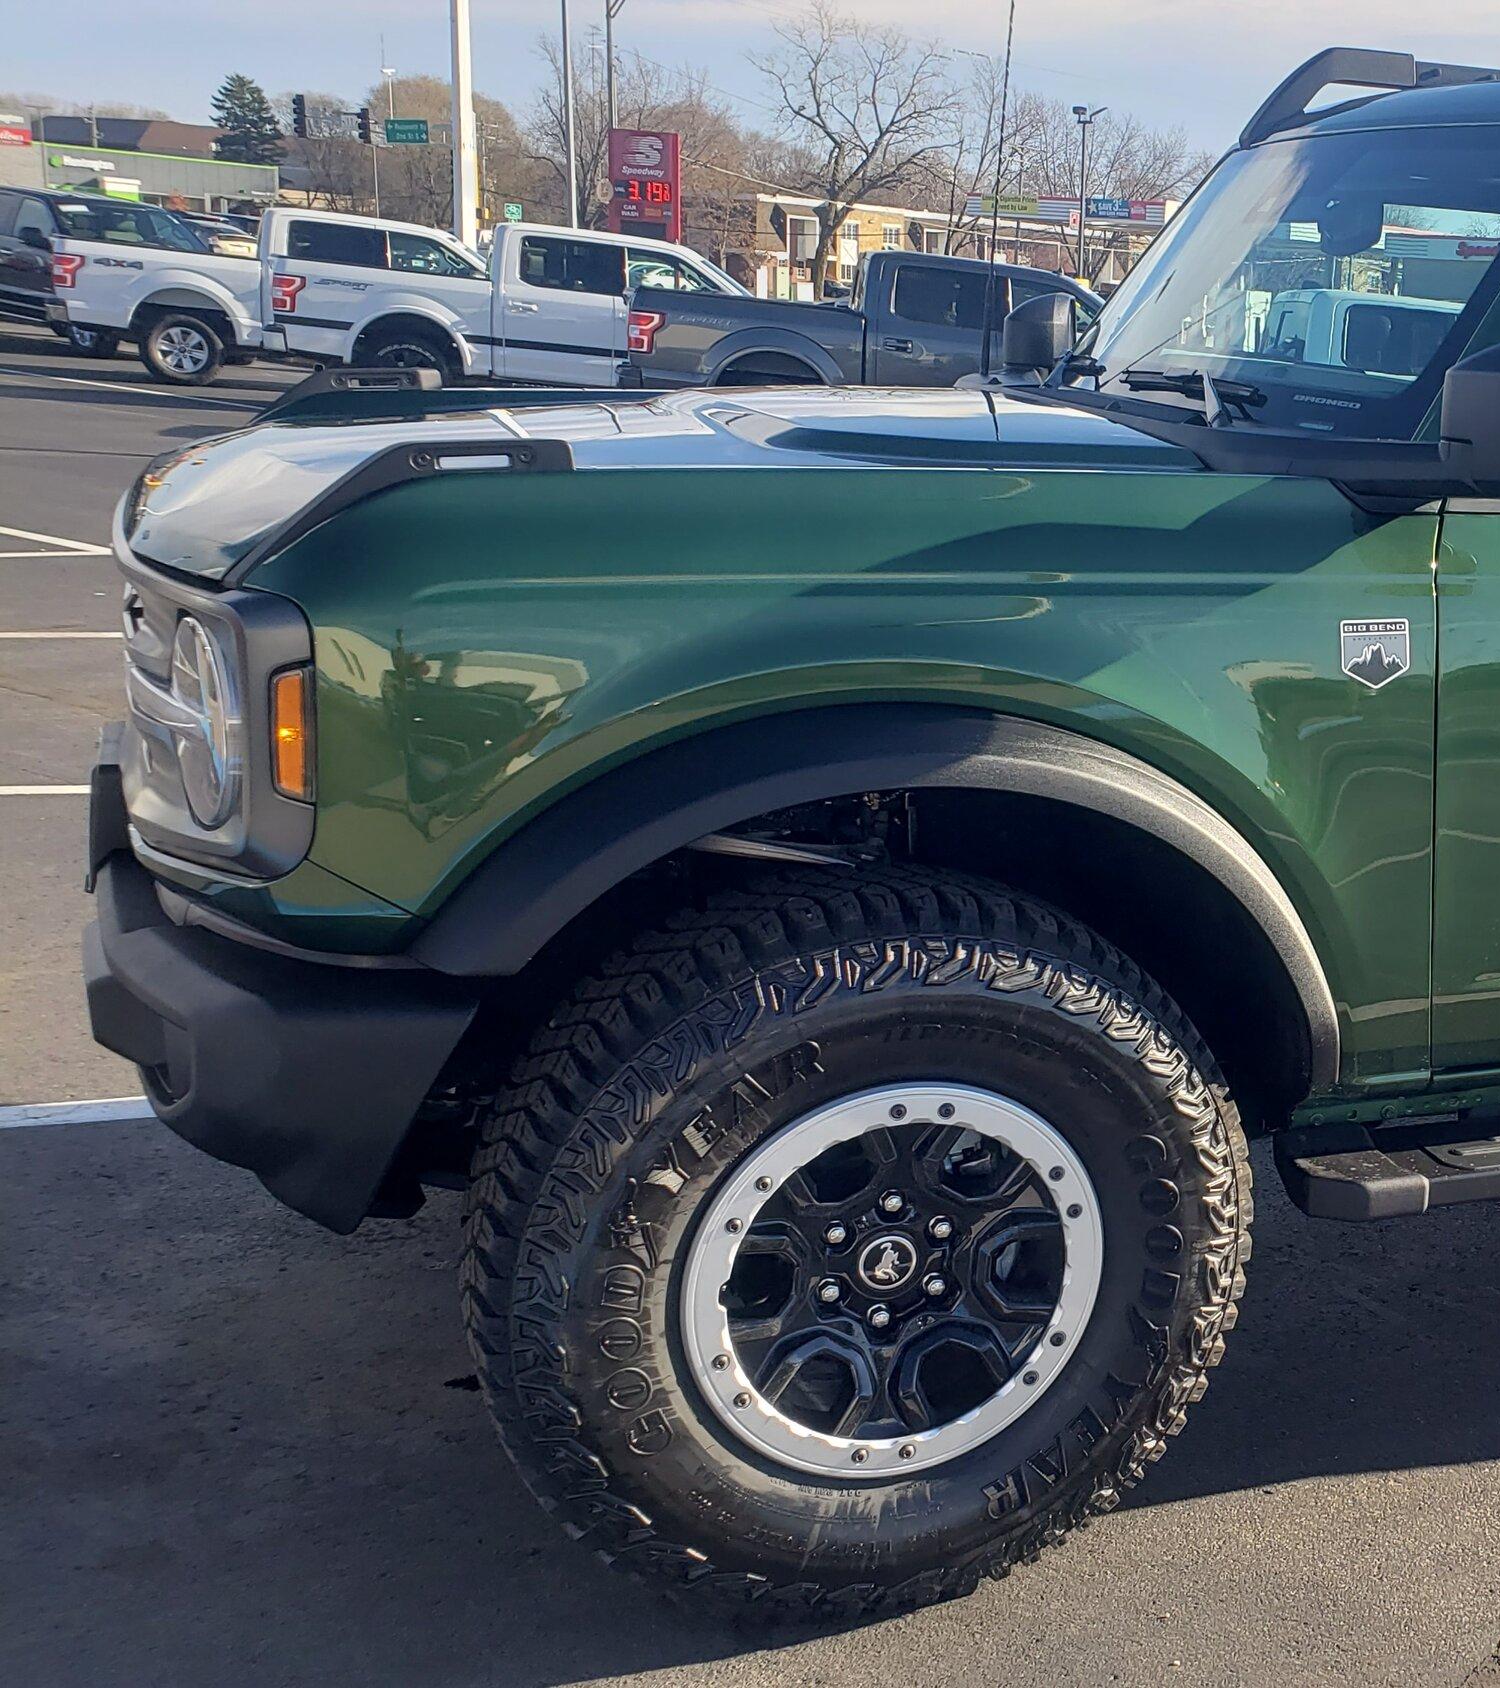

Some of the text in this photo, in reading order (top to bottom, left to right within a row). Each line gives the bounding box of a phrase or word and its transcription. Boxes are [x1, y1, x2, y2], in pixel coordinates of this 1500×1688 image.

[621, 165, 664, 178] Speedway
[313, 278, 374, 289] SPORT
[1293, 394, 1361, 409] BRONCO
[1369, 623, 1405, 631] BEND
